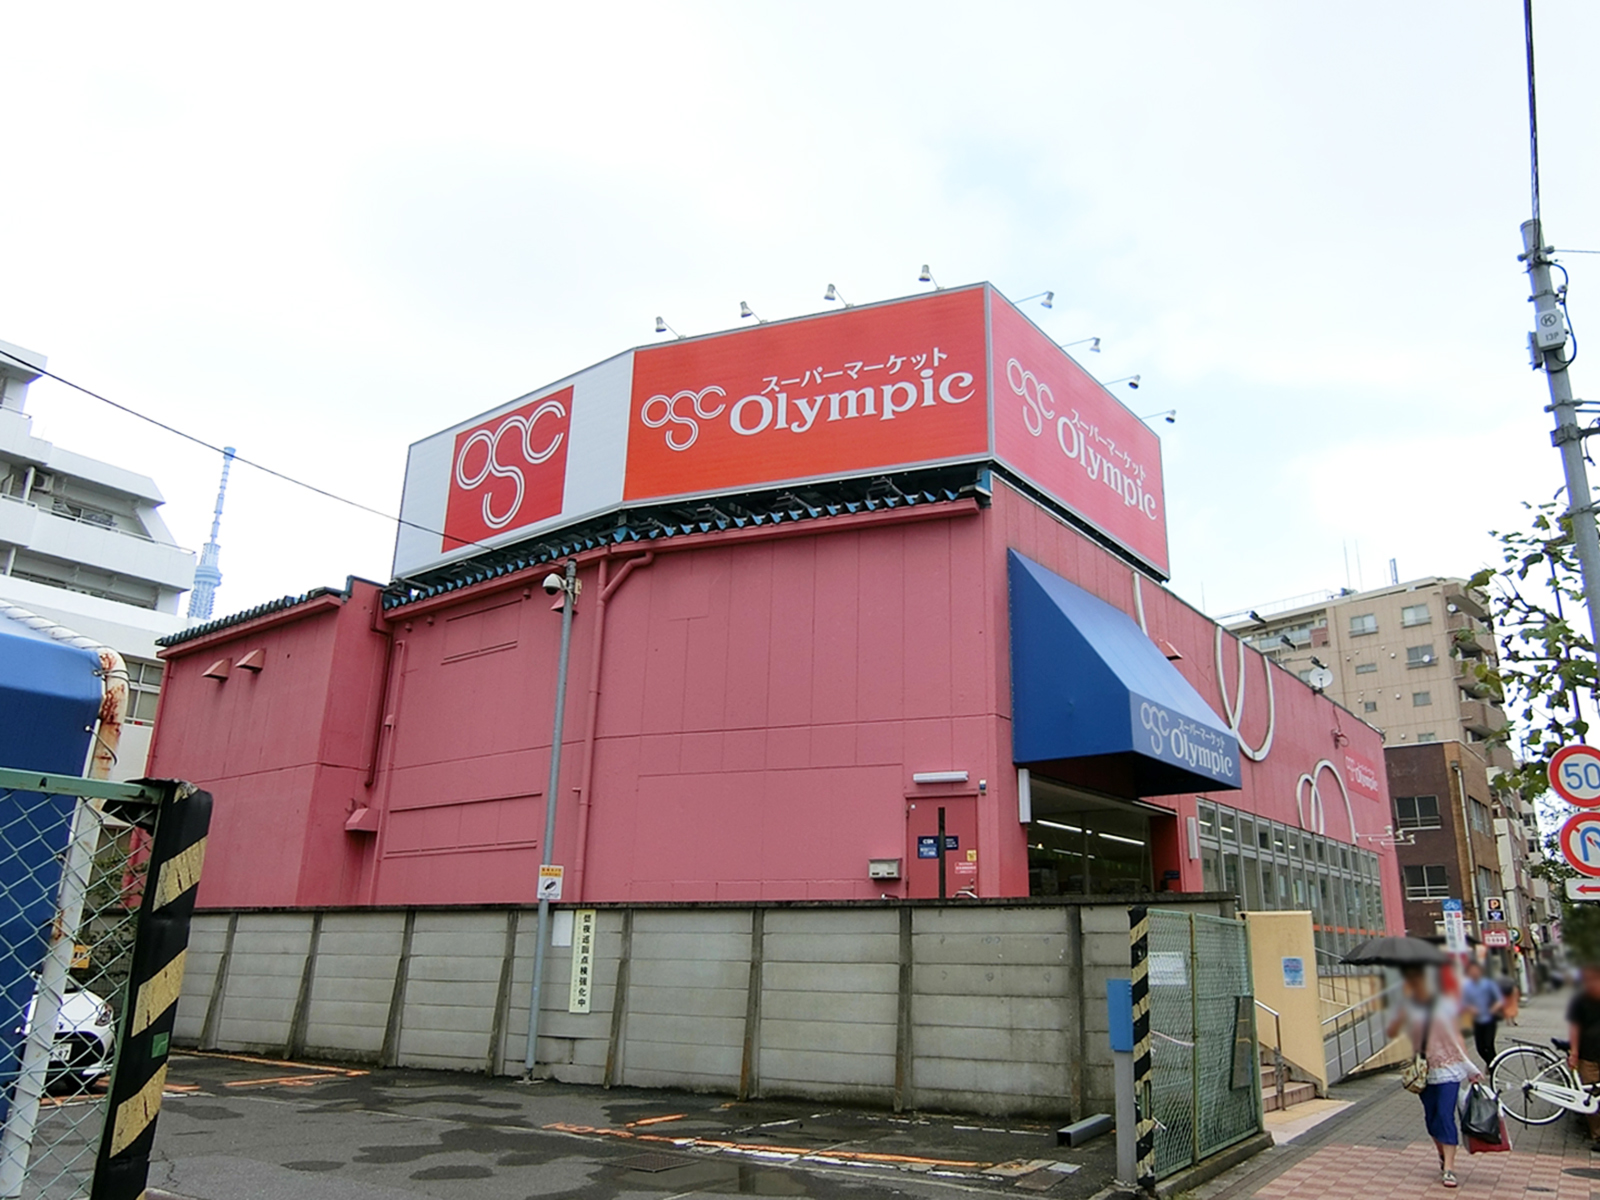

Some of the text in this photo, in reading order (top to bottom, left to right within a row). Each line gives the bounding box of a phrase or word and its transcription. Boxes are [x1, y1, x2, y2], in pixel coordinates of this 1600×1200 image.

[761, 347, 948, 395] スーパーマーケット
[729, 368, 976, 436] Olympic
[1057, 416, 1157, 521] Olympic
[1071, 408, 1147, 481] スーパーマーケット
[1170, 728, 1234, 777] Olympic
[1178, 718, 1226, 749] スーパーマーケット
[1563, 762, 1600, 790] 50
